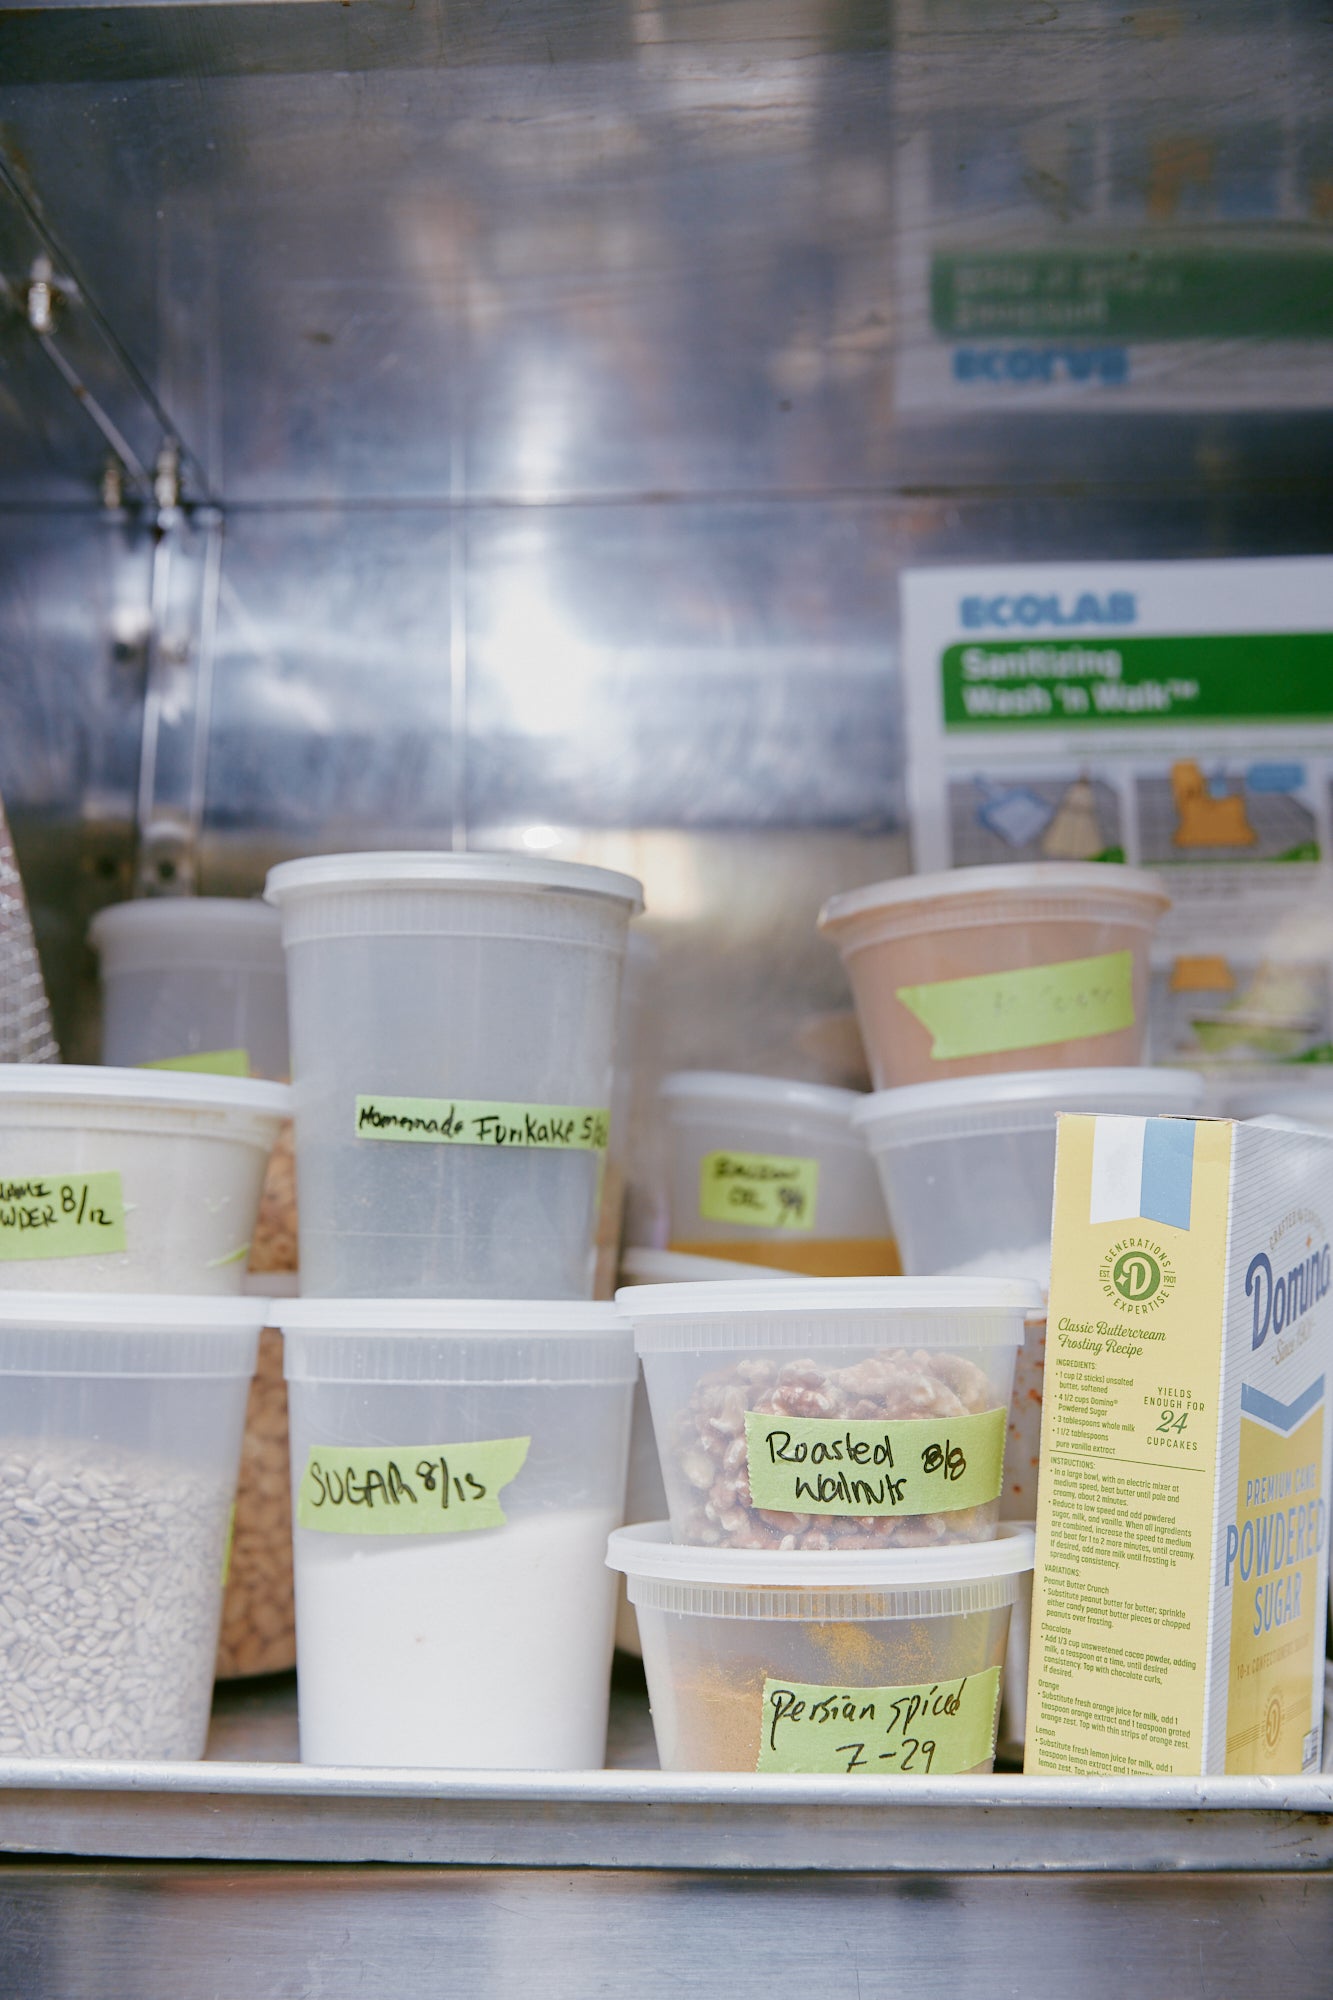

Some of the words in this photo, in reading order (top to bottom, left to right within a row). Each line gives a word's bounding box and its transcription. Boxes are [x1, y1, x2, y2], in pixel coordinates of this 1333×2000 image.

[960, 593, 1137, 628] ECOLAB
[961, 646, 1122, 681] Sanitizing
[962, 684, 1052, 716] Wash
[61, 1185, 114, 1225] 8/12
[1106, 1238, 1171, 1268] GENERATIONS
[1163, 1275, 1176, 1284] 1901
[1103, 1285, 1114, 1298] OF
[1114, 1291, 1169, 1315] EXPERTISE
[1245, 1243, 1330, 1351] Domino
[1058, 1317, 1093, 1333] Classic
[1096, 1321, 1165, 1340] Buttercream
[1058, 1333, 1102, 1355] Frosting
[1105, 1338, 1143, 1358] Recipe
[1063, 1372, 1074, 1380] cup
[1105, 1377, 1133, 1386] unsalted
[1080, 1384, 1108, 1393] softened
[1064, 1393, 1073, 1401] 1/2
[1074, 1396, 1089, 1404] cups
[1143, 1396, 1181, 1408] ENOUGH
[1186, 1401, 1204, 1411] FOR
[1157, 1386, 1191, 1398] YIELDS
[1058, 1403, 1088, 1413] Powdered
[1089, 1407, 1107, 1417] Sugar
[1155, 1409, 1188, 1434] 24
[1060, 1427, 1070, 1436] 1/2
[1071, 1429, 1108, 1440] tablespoons
[1062, 1416, 1100, 1427] tablespoons
[1101, 1422, 1120, 1430] whole
[1121, 1423, 1135, 1431] milk
[765, 1431, 894, 1468] Roasted
[1055, 1440, 1069, 1448] pure
[1070, 1443, 1091, 1451] vanilla
[1092, 1445, 1115, 1454] extract
[1146, 1436, 1197, 1450] CUPCAKES
[1050, 1457, 1095, 1469] INSTRUCTIONS:
[310, 1460, 418, 1508] SUGAR
[1053, 1479, 1077, 1487] medium
[1100, 1484, 1114, 1493] beat
[1116, 1487, 1135, 1496] butter
[1151, 1493, 1166, 1501] pale
[1066, 1469, 1082, 1479] large
[1101, 1475, 1115, 1483] with
[1126, 1478, 1150, 1488] electric
[1152, 1482, 1170, 1491] mixer
[1246, 1470, 1292, 1507] PREMIUM
[1077, 1492, 1095, 1501] about
[1052, 1498, 1075, 1509] Reduce
[1096, 1506, 1115, 1515] speed
[1143, 1513, 1175, 1524] powdered
[1095, 1526, 1122, 1537] increase
[1136, 1533, 1155, 1542] speed
[1165, 1538, 1191, 1547] medium
[1125, 1520, 1143, 1529] When
[1154, 1524, 1191, 1537] ingredients
[1063, 1531, 1077, 1540] beat
[1106, 1539, 1122, 1547] more
[1152, 1546, 1167, 1554] until
[1225, 1498, 1326, 1587] POWDERED
[1050, 1551, 1079, 1563] spreading
[1094, 1548, 1110, 1556] more
[1111, 1550, 1125, 1558] milk
[1126, 1553, 1141, 1561] until
[1142, 1554, 1168, 1567] frosting
[1043, 1576, 1065, 1586] Peanut
[1066, 1579, 1085, 1590] Butter
[1086, 1583, 1109, 1593] Crunch
[1046, 1599, 1064, 1607] either
[1066, 1602, 1085, 1613] candy
[1085, 1606, 1108, 1615] peanut
[1109, 1608, 1129, 1619] butter
[1130, 1613, 1152, 1623] pieces
[1161, 1618, 1190, 1629] chopped
[1047, 1587, 1079, 1600] Substitute
[1080, 1594, 1101, 1604] peanut
[1103, 1597, 1123, 1607] butter
[1158, 1608, 1185, 1618] sprinkle
[1254, 1571, 1302, 1637] SUGAR
[1046, 1609, 1071, 1619] peanuts
[1072, 1614, 1086, 1622] over
[1041, 1622, 1071, 1634] Chocolate
[1065, 1649, 1094, 1660] teaspoon
[1126, 1661, 1141, 1669] until
[1143, 1663, 1167, 1674] desired
[1080, 1643, 1123, 1655] unsweetened
[1124, 1650, 1144, 1659] cocoa
[1172, 1658, 1196, 1670] adding
[1038, 1678, 1059, 1691] Orange
[1095, 1666, 1109, 1674] with
[1110, 1668, 1142, 1680] chocolate
[1042, 1690, 1073, 1704] Substitute
[1074, 1697, 1091, 1707] fresh
[1092, 1702, 1114, 1713] orange
[1115, 1705, 1131, 1716] juice
[770, 1689, 875, 1751] Persian
[1035, 1725, 1055, 1736] Lemon
[1040, 1712, 1061, 1723] orange
[1091, 1723, 1105, 1731] with
[1106, 1725, 1119, 1734] thin
[1120, 1729, 1139, 1739] strips
[1149, 1735, 1172, 1746] orange
[1041, 1701, 1069, 1713] teaspoon
[1070, 1708, 1092, 1719] orange
[1093, 1713, 1116, 1723] extract
[1136, 1721, 1166, 1733] teaspoon
[1168, 1728, 1190, 1738] grated
[1039, 1737, 1071, 1751] Substitute
[1072, 1744, 1088, 1755] fresh
[1089, 1748, 1109, 1759] lemon
[1110, 1753, 1126, 1763] juice
